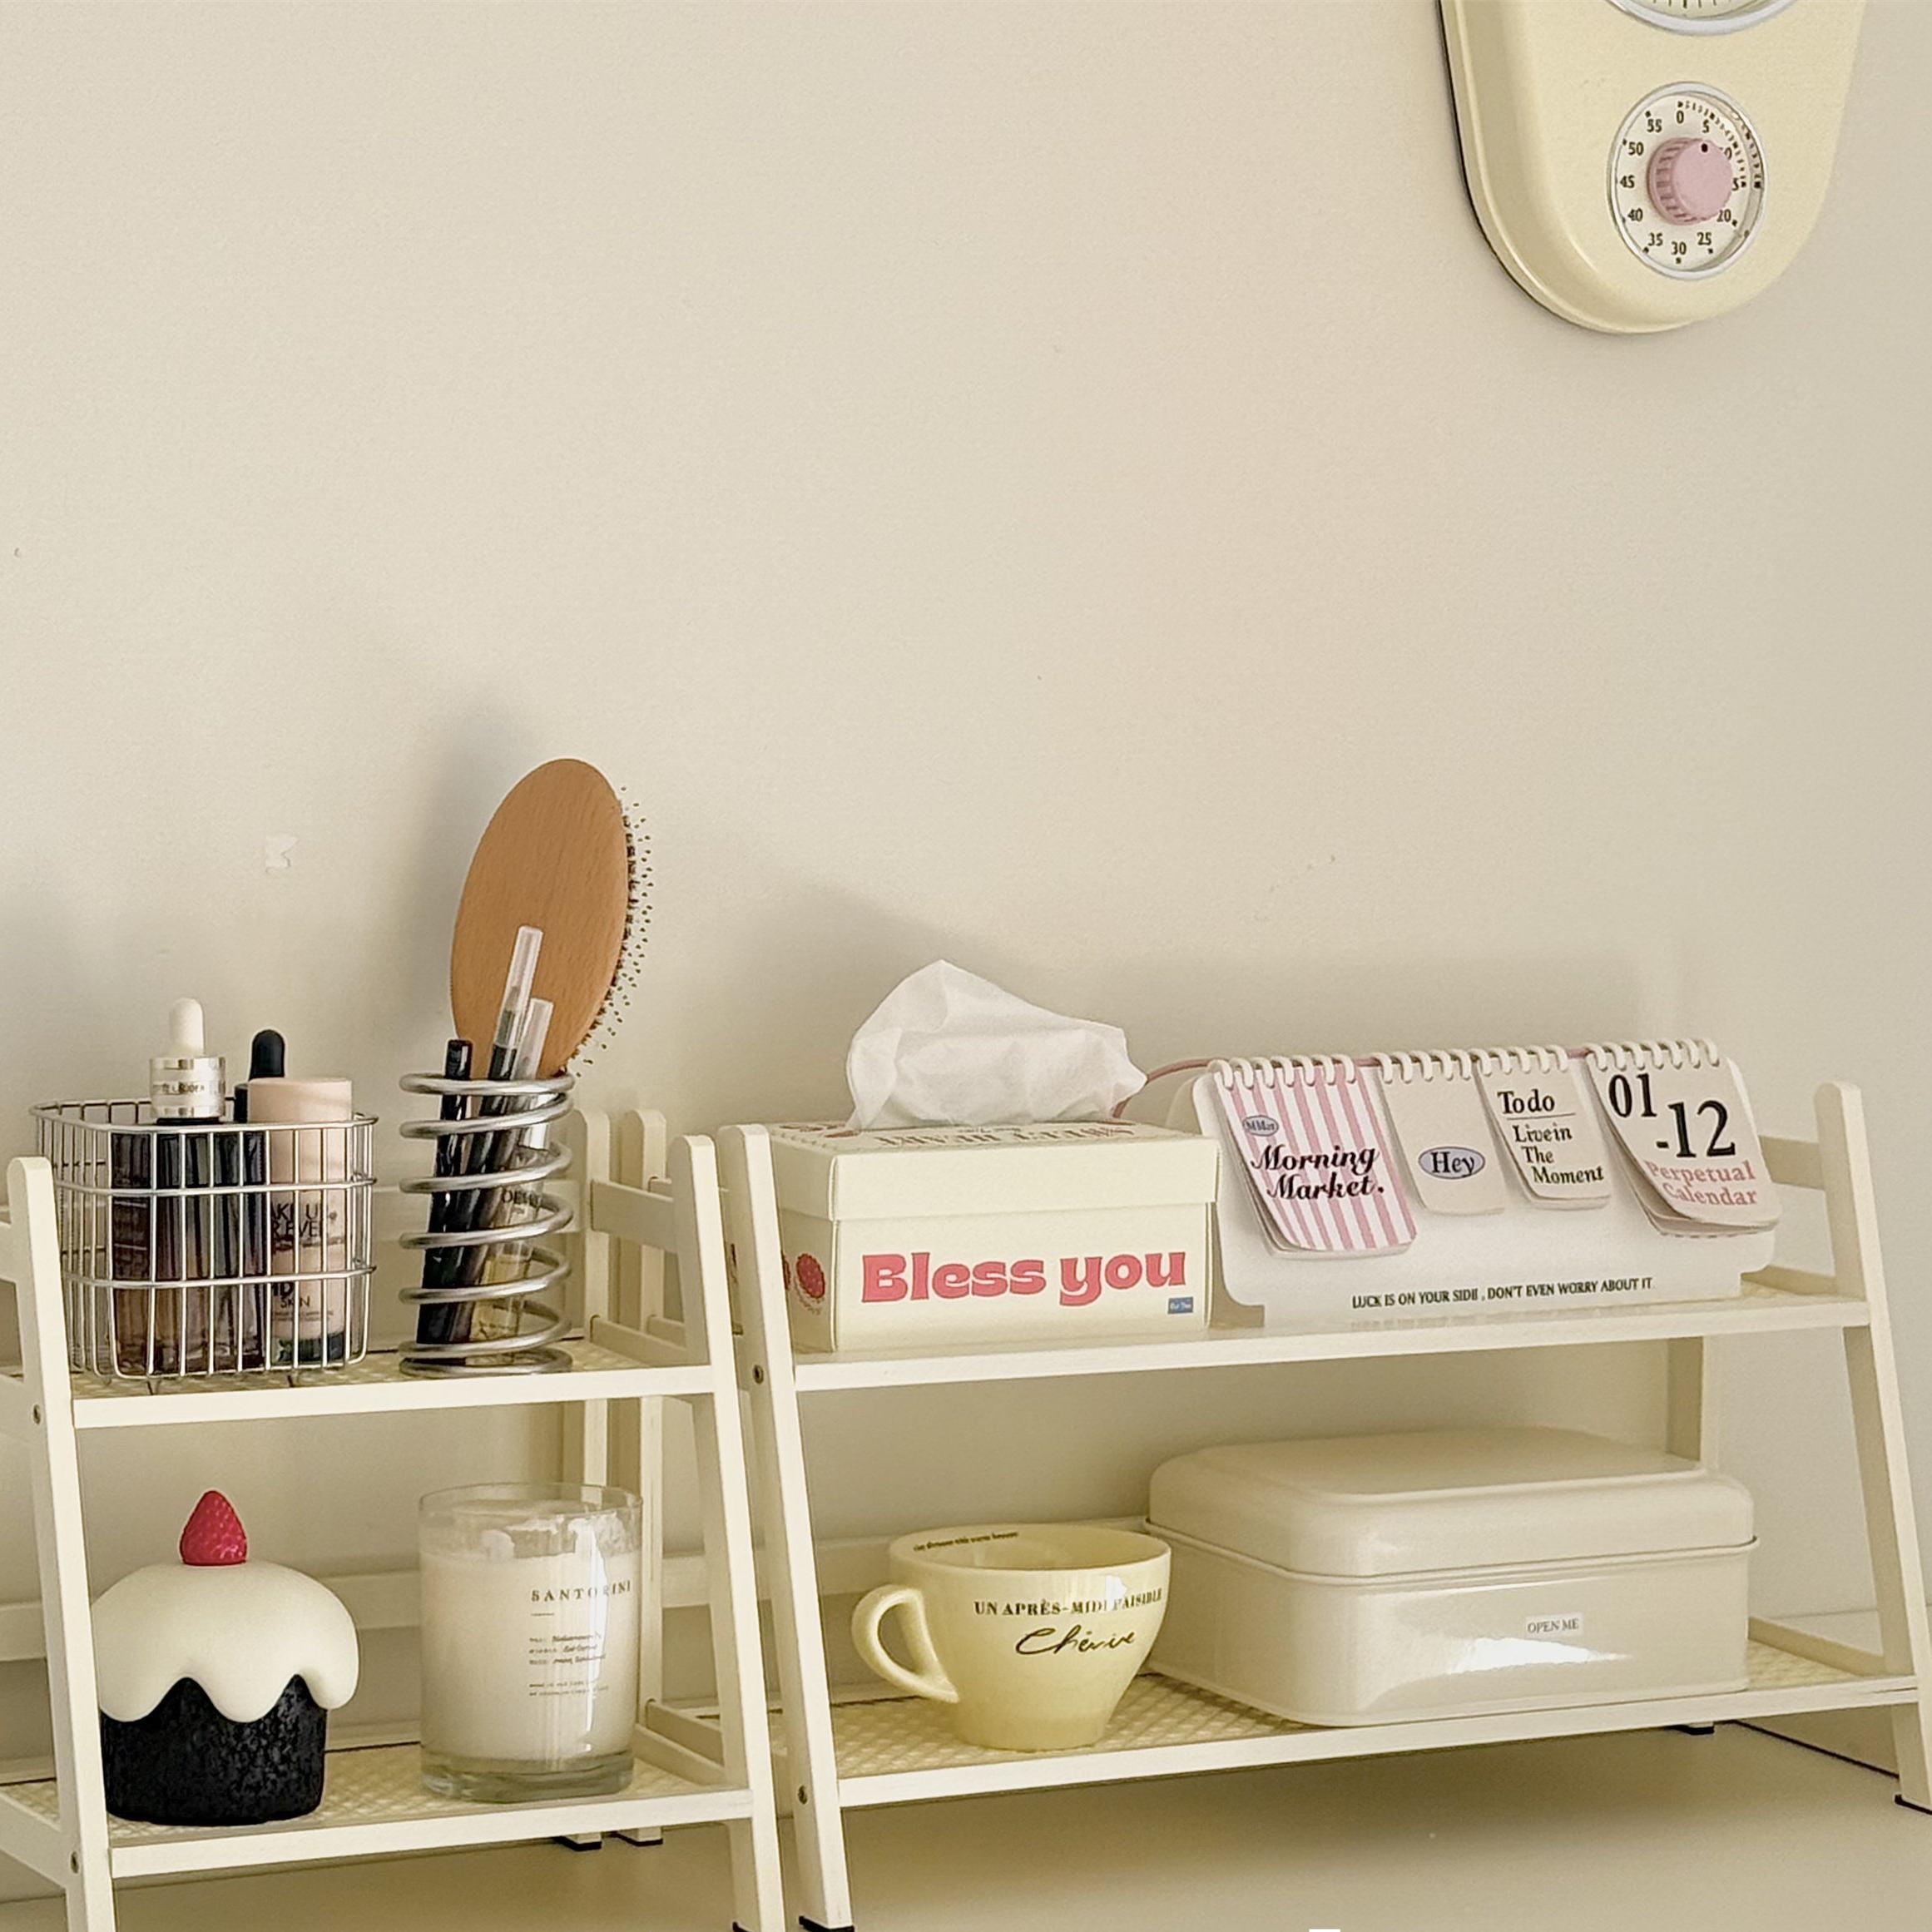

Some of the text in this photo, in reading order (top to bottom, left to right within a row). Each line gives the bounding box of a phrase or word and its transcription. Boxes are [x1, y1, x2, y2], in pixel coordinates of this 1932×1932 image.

[1676, 110, 1684, 124] 0
[1647, 119, 1662, 133] 55
[1702, 119, 1710, 133] 5
[1627, 141, 1644, 156] 50
[1620, 175, 1635, 189] 45
[1627, 207, 1643, 222] 40
[1648, 232, 1663, 246] 35
[1697, 231, 1712, 245] 25
[1671, 241, 1687, 255] 30
[1608, 1073, 1657, 1118] 01
[1250, 1144, 1380, 1177] Morning
[1521, 1146, 1554, 1164] The
[1429, 1151, 1474, 1178] Hey
[1644, 1159, 1756, 1187] Perpetual
[1531, 1166, 1605, 1185] Moment
[1266, 1172, 1385, 1200] Market.
[1662, 1182, 1758, 1206] Calendar
[861, 1251, 1047, 1303] Bless
[1058, 1251, 1186, 1306] you
[1351, 1295, 1382, 1309] LUCK
[1384, 1294, 1396, 1307] IS
[1398, 1292, 1415, 1305] ON
[1419, 1290, 1450, 1304] YOUR
[1488, 1285, 1523, 1300] DON'T
[1525, 1284, 1554, 1297] EVEN
[1558, 1281, 1598, 1295] WORRY
[1601, 1278, 1639, 1292] ABOUT
[1642, 1277, 1653, 1290] IT
[531, 1579, 632, 1603] SANTORINI
[973, 1601, 998, 1616] UN
[1527, 1617, 1580, 1634] OPEN ME
